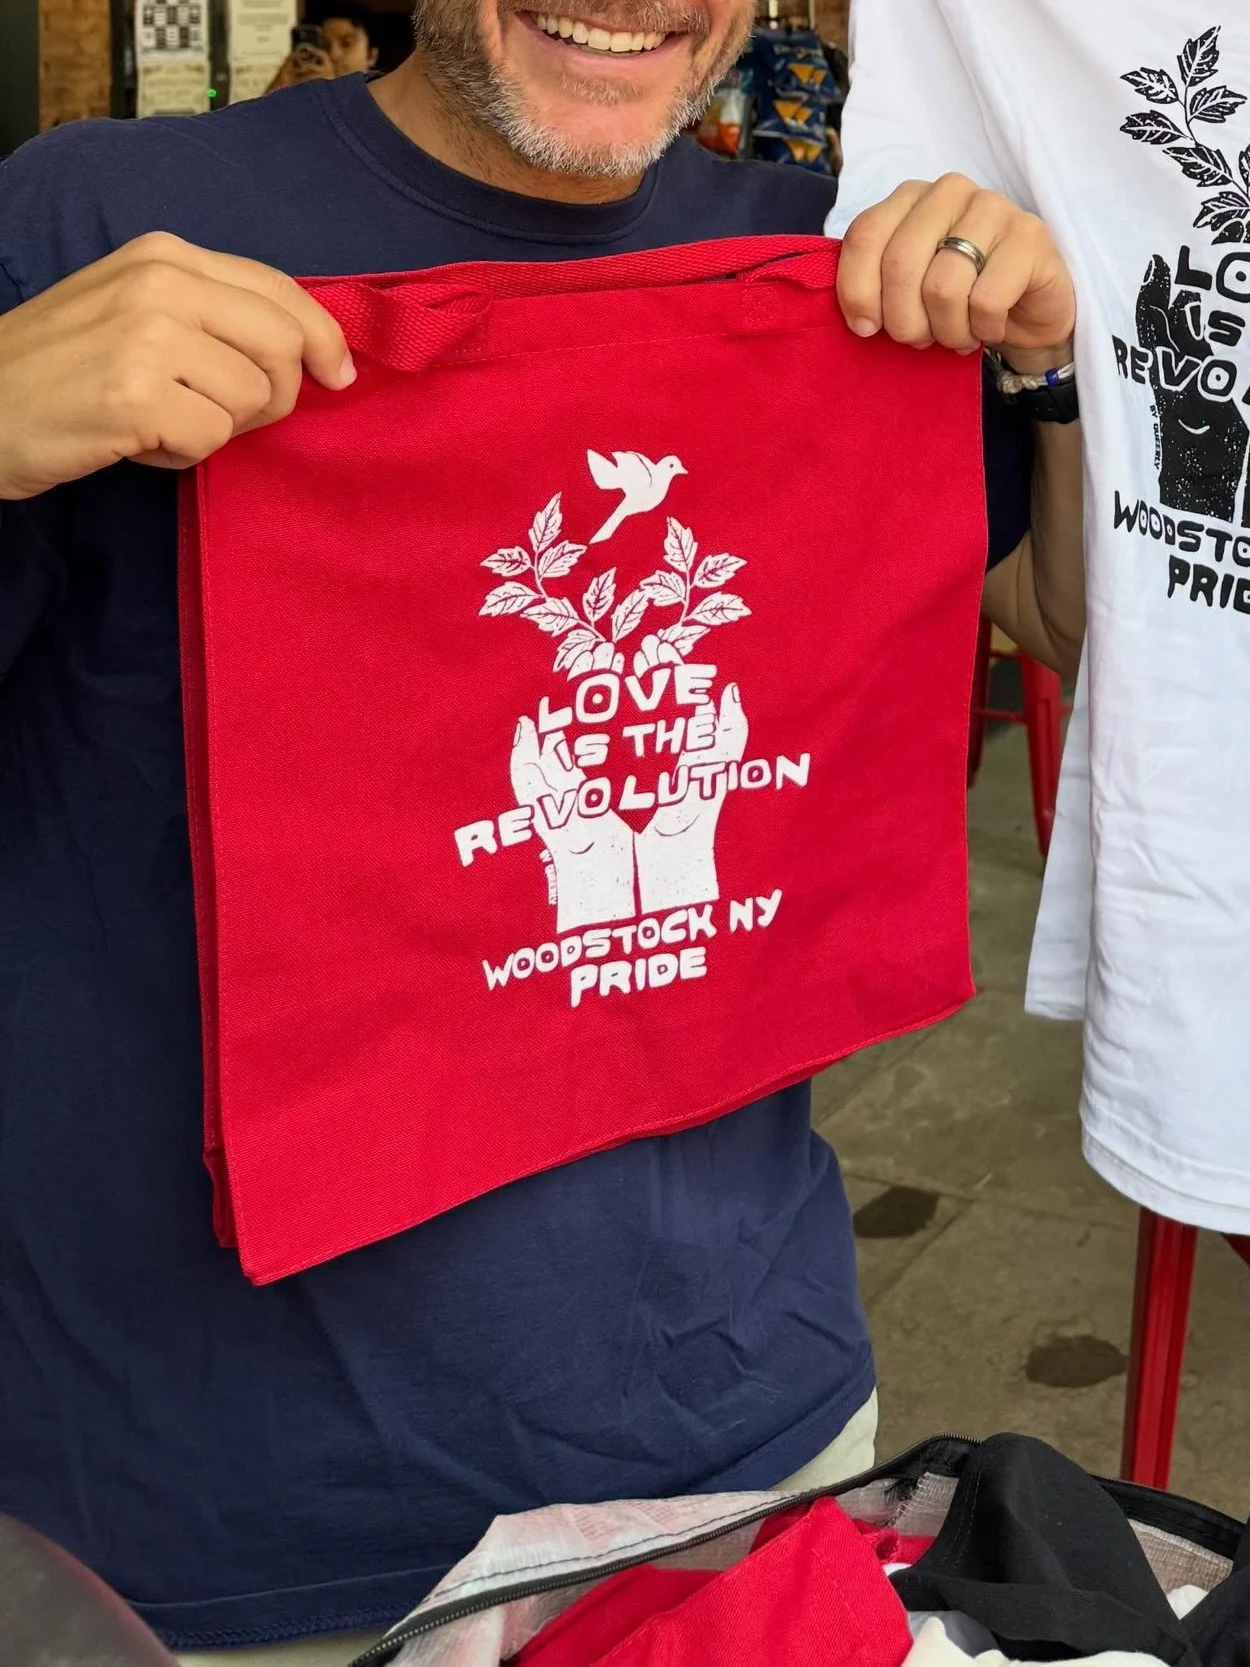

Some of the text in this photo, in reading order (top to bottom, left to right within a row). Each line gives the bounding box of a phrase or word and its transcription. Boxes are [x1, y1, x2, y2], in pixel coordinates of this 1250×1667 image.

[1190, 302, 1245, 346] IS
[537, 664, 718, 734] LOVE
[556, 713, 717, 771] IS THE
[454, 752, 810, 866] REVOLUTION
[482, 889, 782, 990] WOODSTOCK NY
[570, 947, 707, 1008] PRIDE
